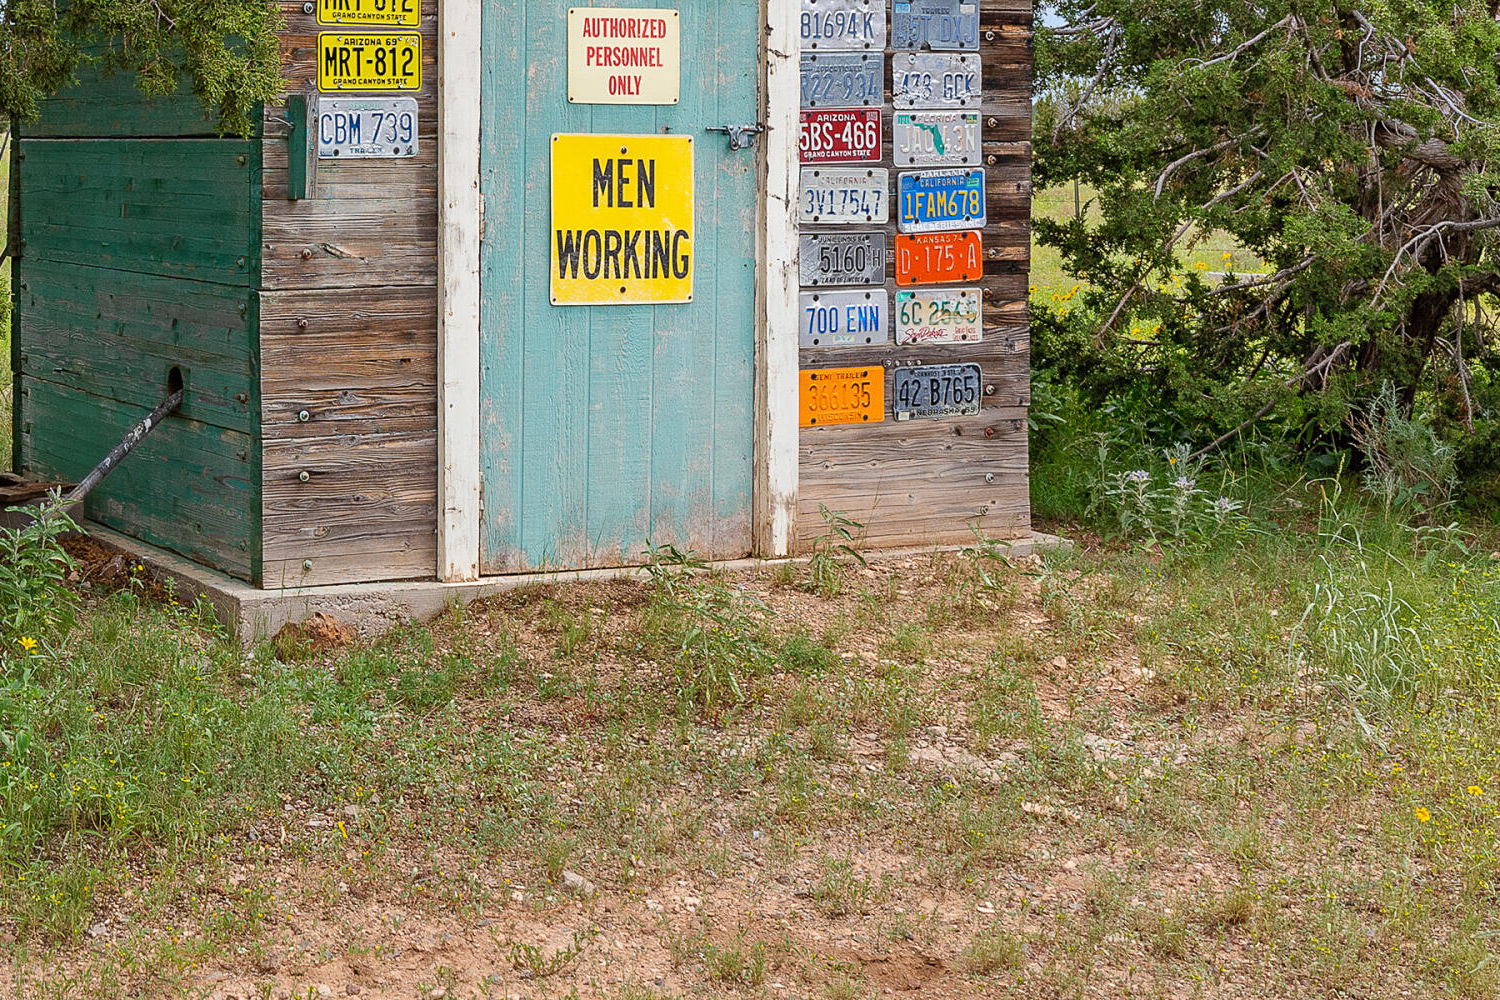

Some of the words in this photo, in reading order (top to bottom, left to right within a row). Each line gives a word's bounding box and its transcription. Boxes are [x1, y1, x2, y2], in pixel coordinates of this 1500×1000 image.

[357, 12, 385, 20] CANYON
[583, 17, 667, 39] AUTHORIZED
[344, 38, 382, 46] ARIZONA
[386, 38, 398, 46] 69
[325, 46, 414, 77] MRT-812
[586, 46, 664, 67] PERSONNEL
[608, 75, 642, 96] ONLY
[321, 113, 361, 144] CBM
[372, 112, 413, 144] 739
[817, 113, 856, 122] ARIZONA
[917, 115, 957, 123] FLORIDA
[800, 121, 877, 151] 5BS-466
[592, 158, 655, 208] MEN
[821, 176, 867, 185] CALIFORNIA
[920, 177, 964, 188] CALIFORNIA
[905, 190, 980, 220] 1FAM678
[916, 235, 951, 244] KANSAS
[556, 229, 690, 280] WORKING
[806, 306, 839, 334] 700
[846, 305, 879, 332] ENN
[901, 301, 922, 325] 6C
[836, 372, 865, 380] TRAILER
[916, 408, 960, 416] NEBRASKA
